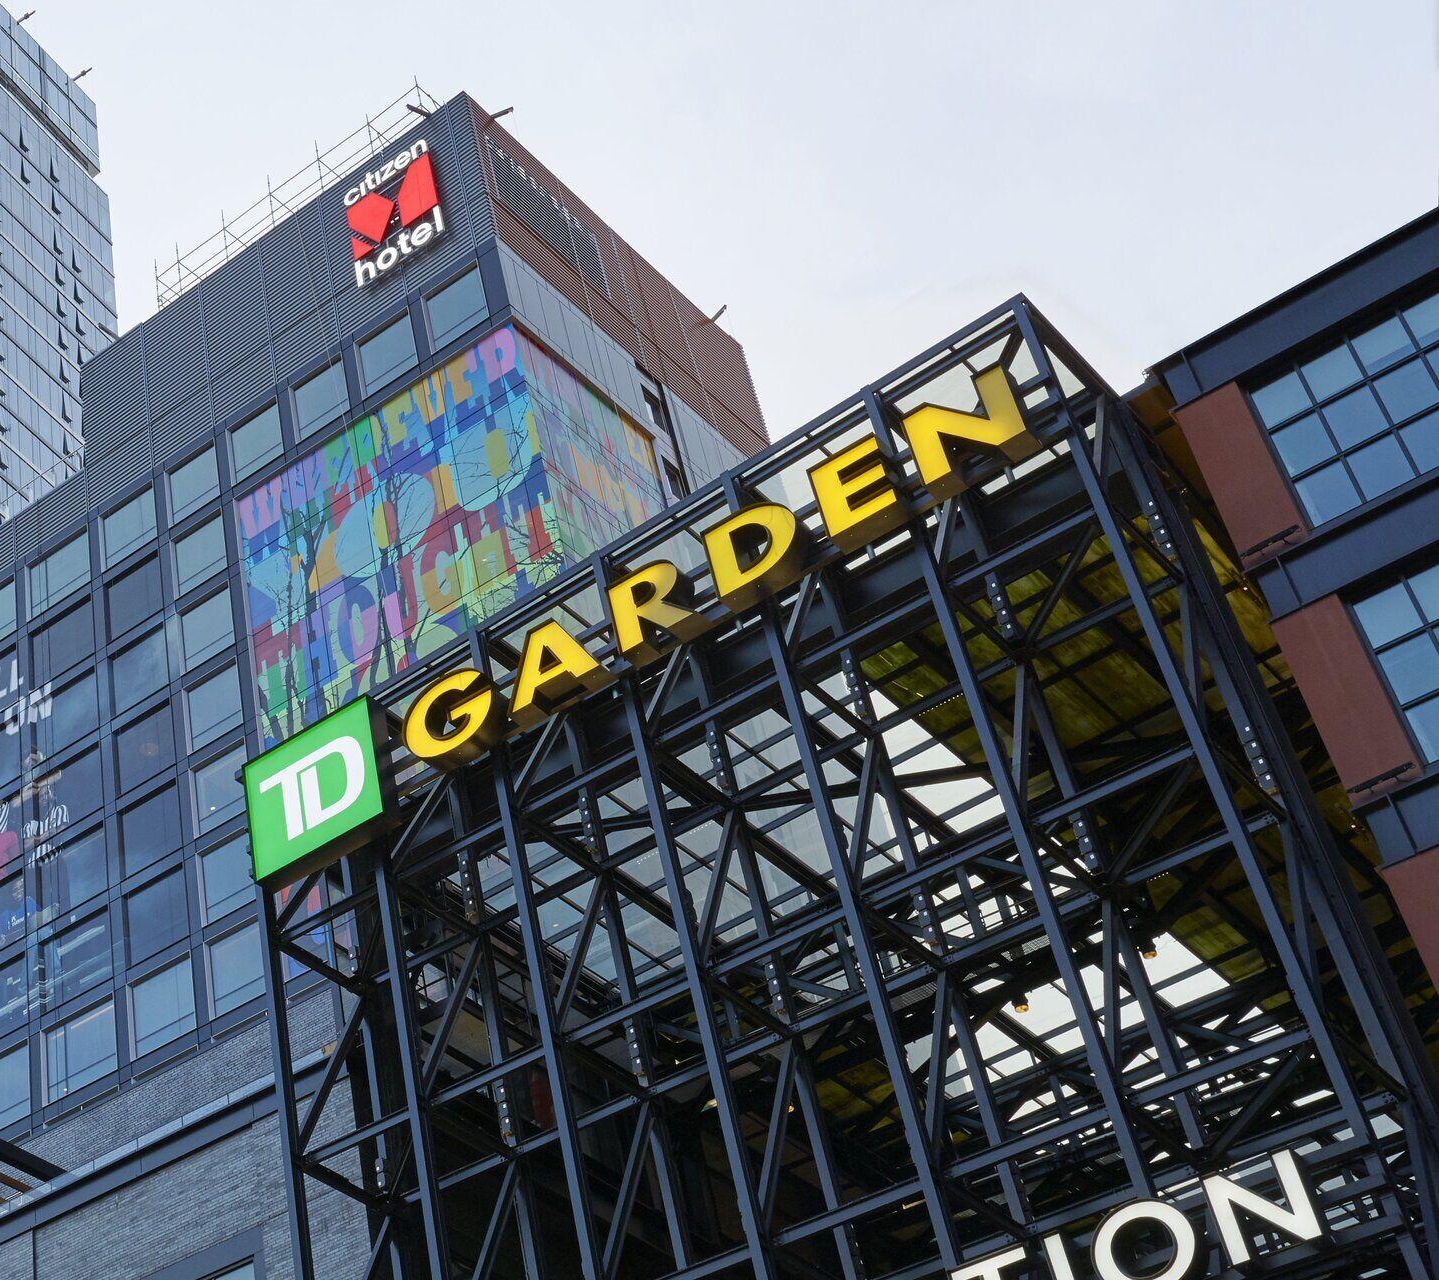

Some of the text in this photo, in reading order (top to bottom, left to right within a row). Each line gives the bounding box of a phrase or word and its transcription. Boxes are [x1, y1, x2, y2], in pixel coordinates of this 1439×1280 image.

[343, 139, 429, 207] citizen
[354, 205, 445, 288] hotel
[259, 736, 365, 841] TD
[403, 363, 1030, 764] GARDEN
